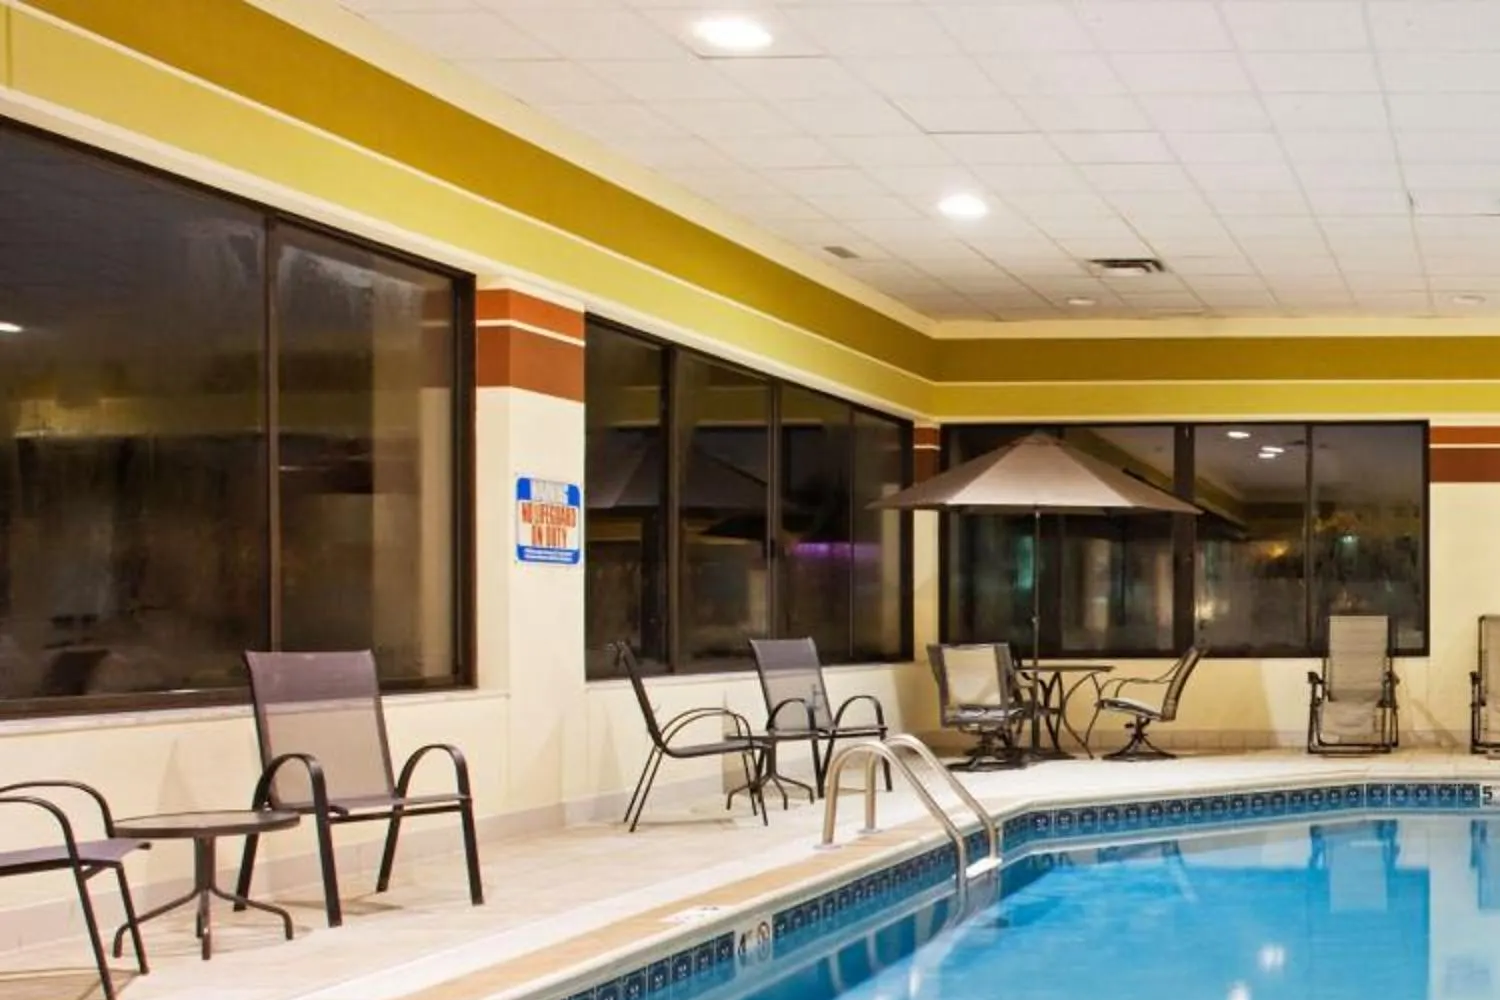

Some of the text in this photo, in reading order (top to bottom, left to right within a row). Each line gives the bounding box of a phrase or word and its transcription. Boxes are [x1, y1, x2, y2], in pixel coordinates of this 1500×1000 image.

[521, 502, 576, 528] NO LIFEGUARD
[531, 525, 567, 549] ON DUTY
[1482, 785, 1493, 805] 5
